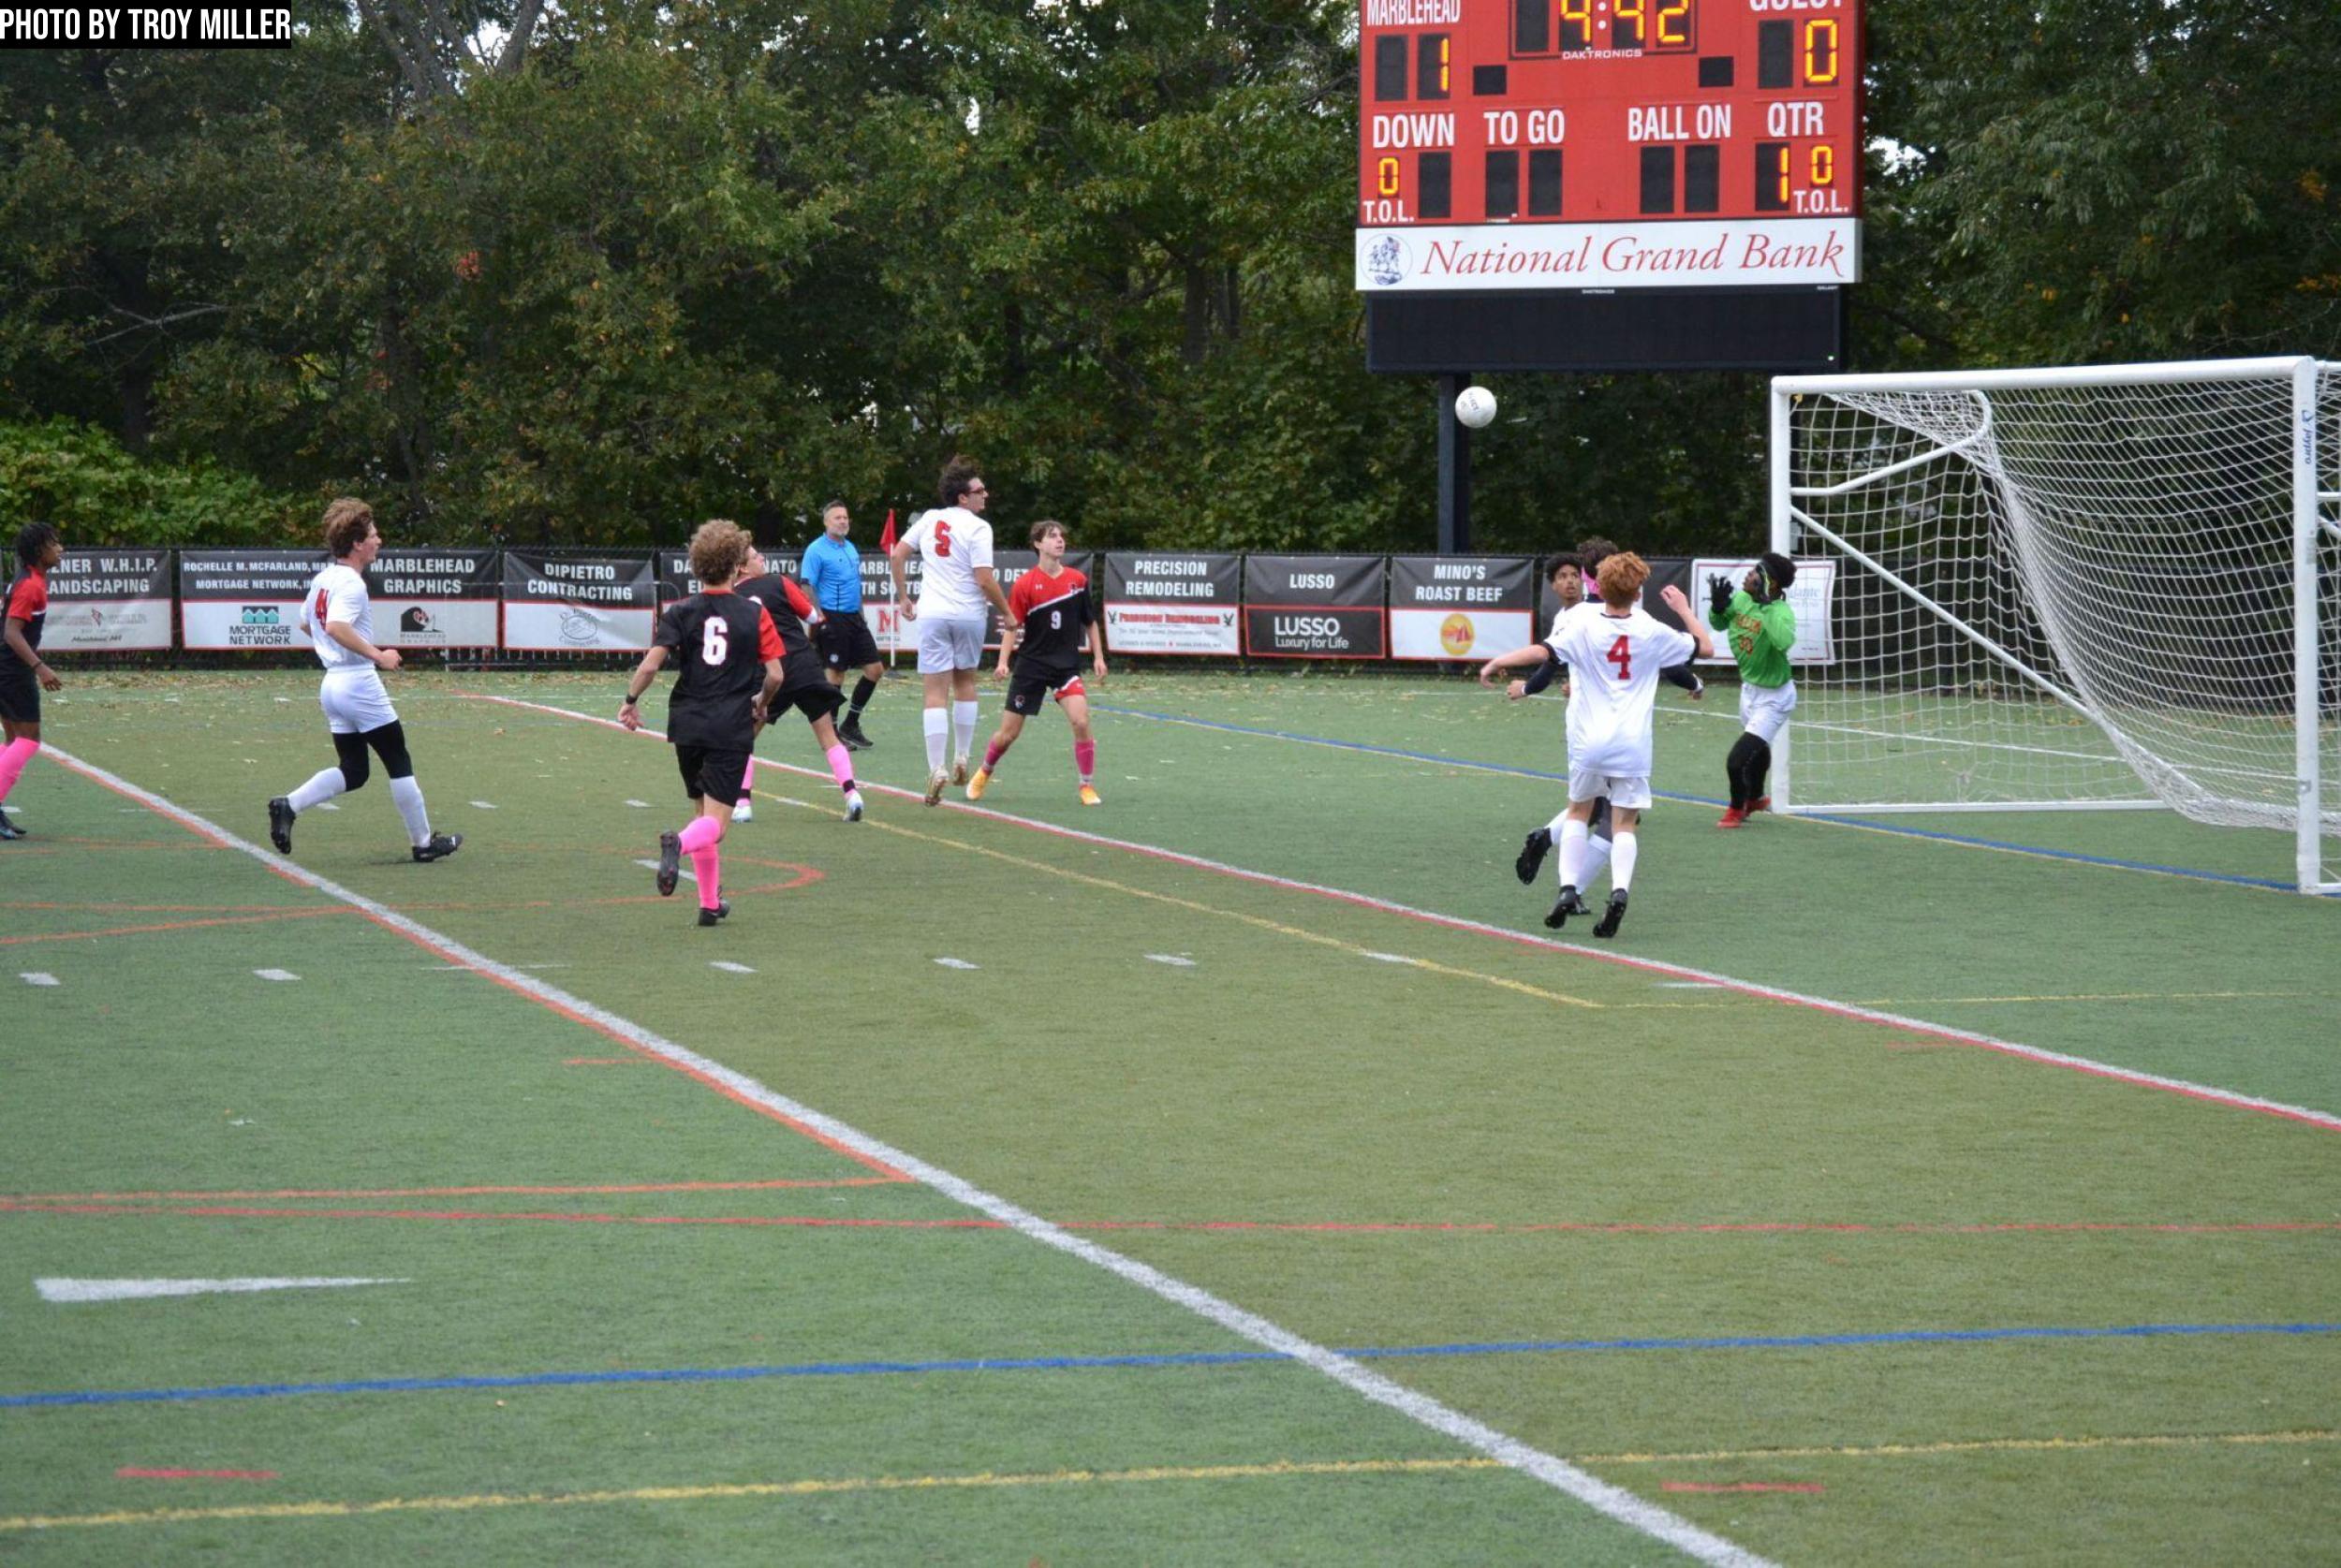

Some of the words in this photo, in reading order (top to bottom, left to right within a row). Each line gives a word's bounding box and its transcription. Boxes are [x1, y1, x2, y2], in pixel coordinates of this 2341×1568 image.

[1366, 0, 1461, 26] MARBLEHEAD
[1562, 49, 1642, 60] DAKTRONICS
[1804, 19, 1838, 82] 0
[1439, 37, 1450, 92] 1
[1483, 110, 1519, 144] TO
[1527, 110, 1565, 144] GO
[1627, 106, 1689, 141] BALL
[1696, 104, 1731, 139] ON
[1767, 102, 1824, 138] QTR
[1373, 113, 1455, 148] DOWN
[1779, 147, 1789, 203] 1
[1810, 146, 1833, 184] 0
[1377, 157, 1399, 196] 0
[1362, 199, 1415, 223] T.O.L.
[1792, 190, 1848, 213] T.O.L.
[1420, 235, 1593, 275] National
[1601, 232, 1729, 272] Grand
[1738, 229, 1845, 277] Bank
[935, 520, 951, 557] 5
[100, 558, 157, 573] W.H.I.P.
[184, 562, 233, 572] ROCHELLE
[236, 562, 248, 572] M.
[249, 562, 312, 573] MCFARLAND,
[370, 558, 476, 574] MARBLEHEAD
[544, 563, 615, 580] DIPIETRO
[1134, 560, 1207, 576] PRECISION
[1434, 564, 1486, 579] MINO'S
[47, 579, 150, 594] ANDSCAPING
[196, 579, 249, 590] MORTGAGE
[252, 579, 302, 592] NETWORK,
[383, 579, 463, 594] GRAPHICS
[527, 579, 633, 601] CONTRACTING
[1126, 581, 1215, 597] REMODELING
[1289, 573, 1335, 589] LUSSO
[1415, 586, 1461, 601] ROAST
[1465, 587, 1503, 601] BEEF
[1051, 610, 1062, 630] 9
[1274, 616, 1340, 636] LUSSO
[228, 625, 291, 636] MORTGAGE
[228, 636, 291, 645] NETWORK
[702, 616, 729, 667] 6
[1274, 637, 1310, 651] Luxury
[1311, 637, 1327, 648] for
[1328, 637, 1349, 649] Life
[1606, 635, 1631, 680] 4
